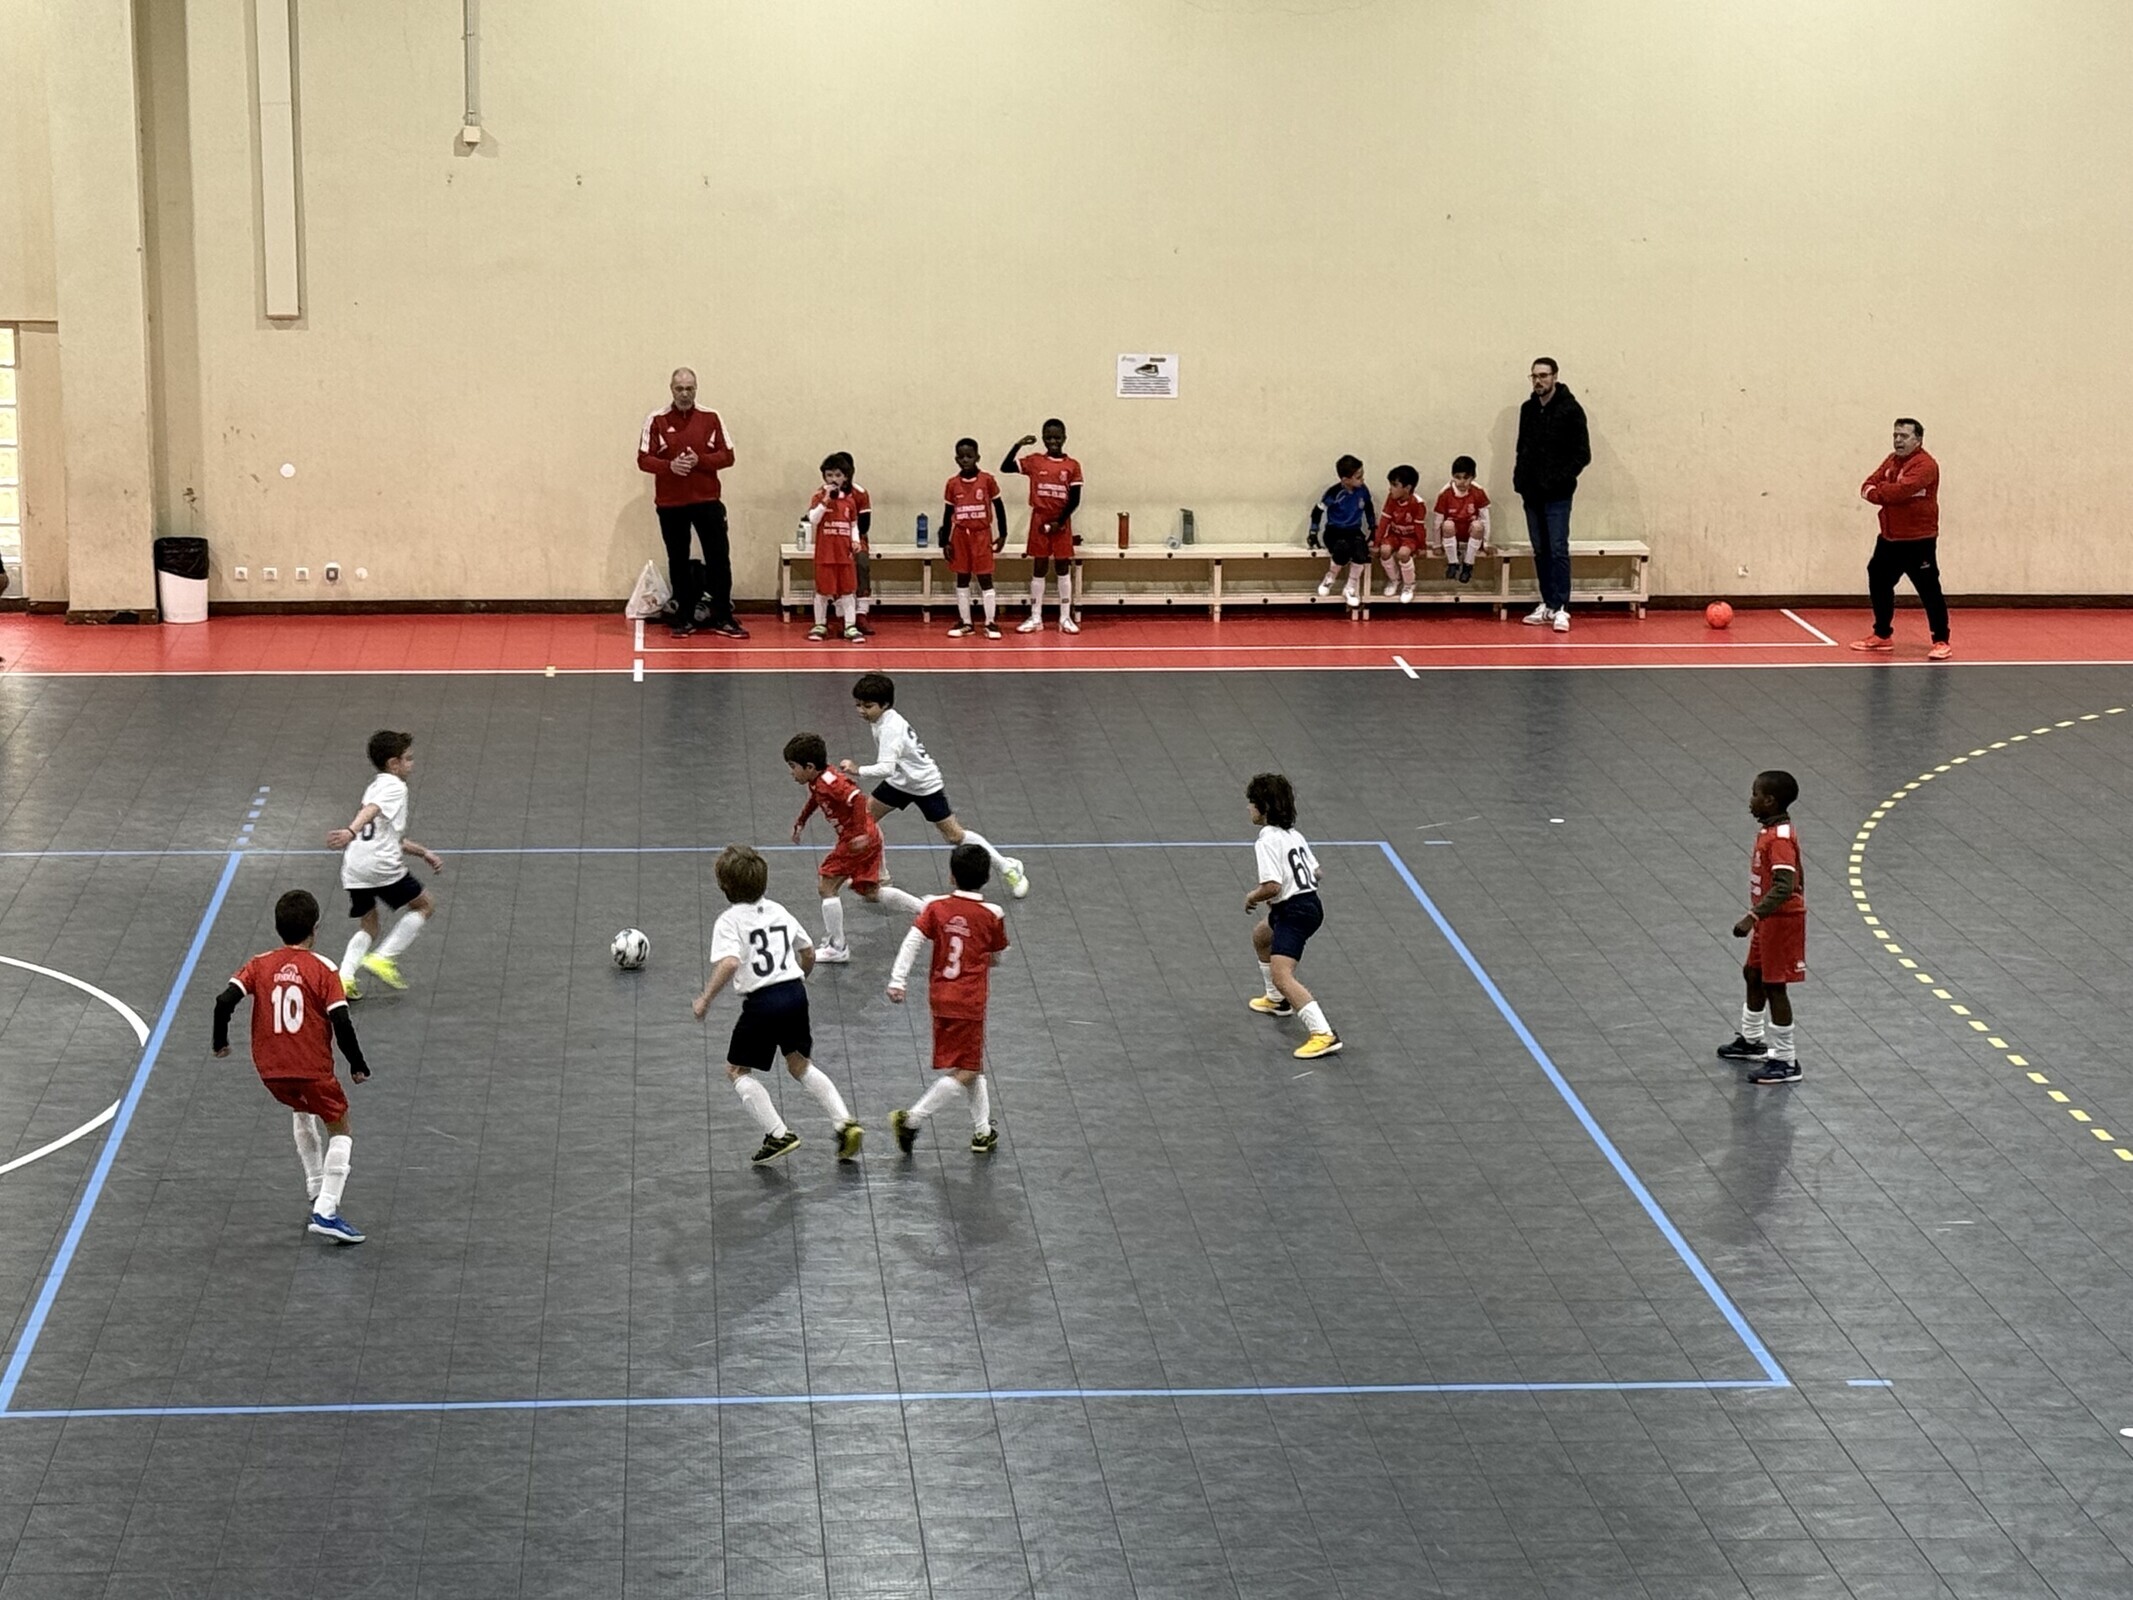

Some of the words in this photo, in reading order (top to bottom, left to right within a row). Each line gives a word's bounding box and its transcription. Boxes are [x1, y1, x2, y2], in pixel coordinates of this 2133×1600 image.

[1288, 846, 1319, 890] 60
[749, 925, 791, 977] 37
[942, 936, 964, 980] 3
[271, 985, 304, 1034] 10
